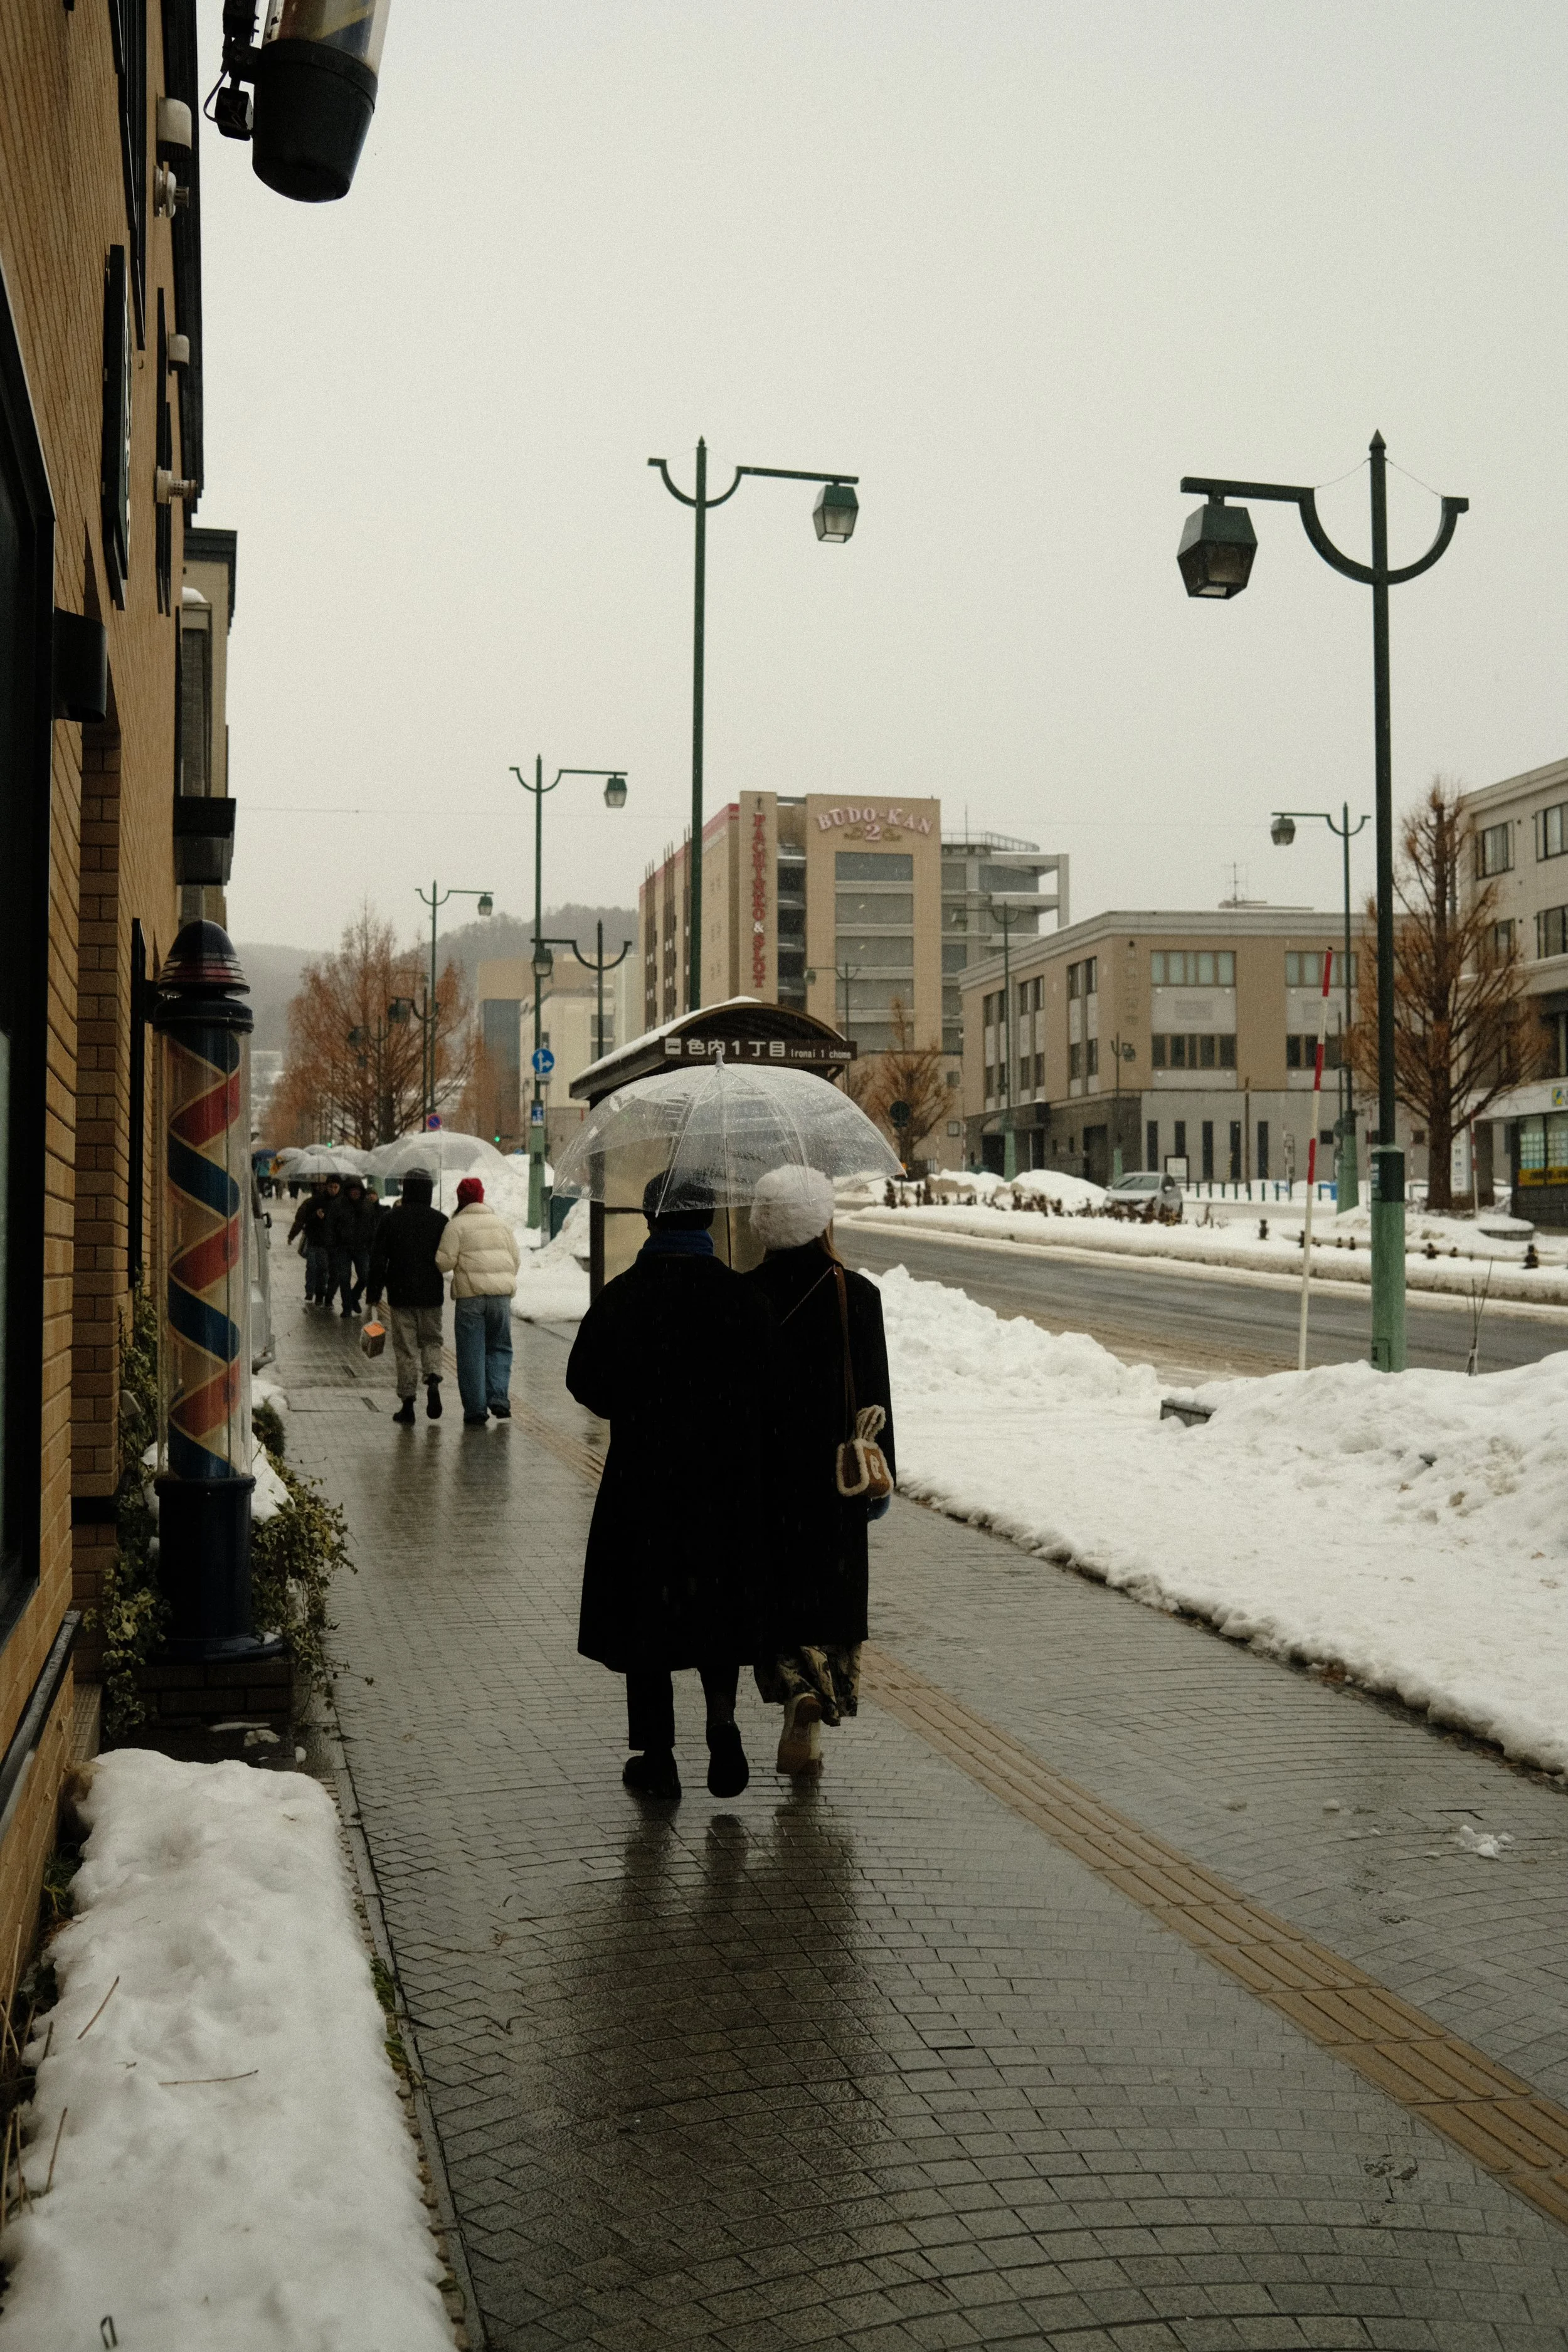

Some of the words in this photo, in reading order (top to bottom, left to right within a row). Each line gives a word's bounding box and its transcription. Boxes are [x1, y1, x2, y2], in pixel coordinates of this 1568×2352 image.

[817, 807, 933, 835] BUDO-KAN
[865, 823, 881, 840] 2
[753, 813, 766, 921] PACHINKO
[754, 921, 764, 933] &
[753, 933, 766, 988] SLOT
[820, 1049, 825, 1059] 1
[829, 1049, 851, 1059] chome
